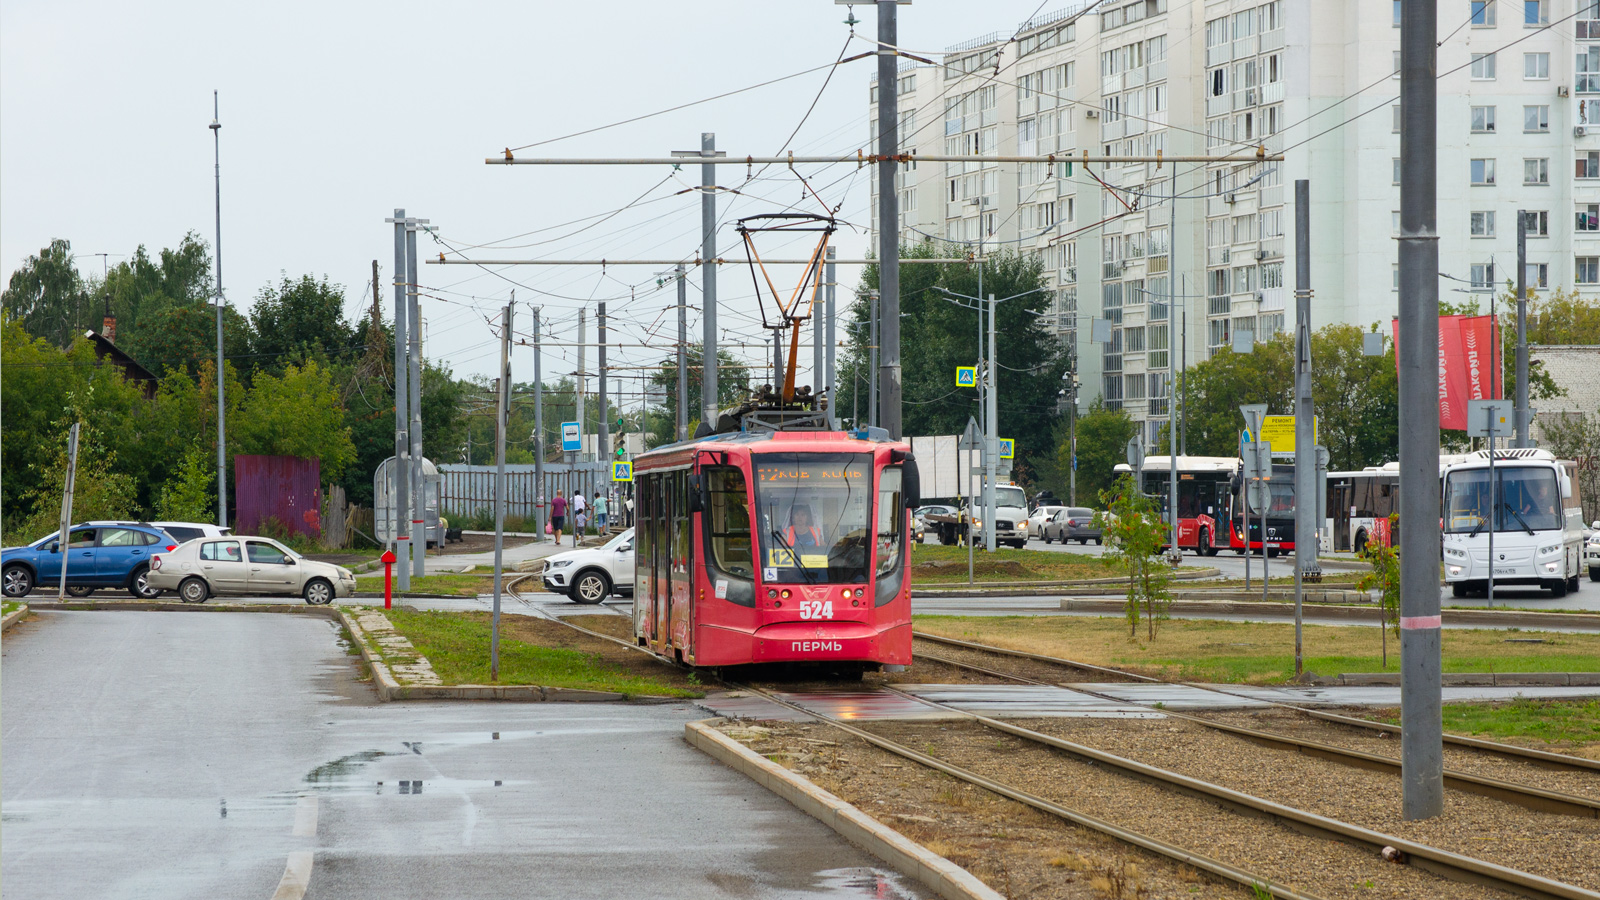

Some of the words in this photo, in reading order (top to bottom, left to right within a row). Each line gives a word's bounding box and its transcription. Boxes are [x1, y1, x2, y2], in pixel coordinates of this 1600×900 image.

[772, 550, 793, 565] 12
[800, 601, 834, 619] 524
[792, 641, 842, 651] ПЕРМЬ
